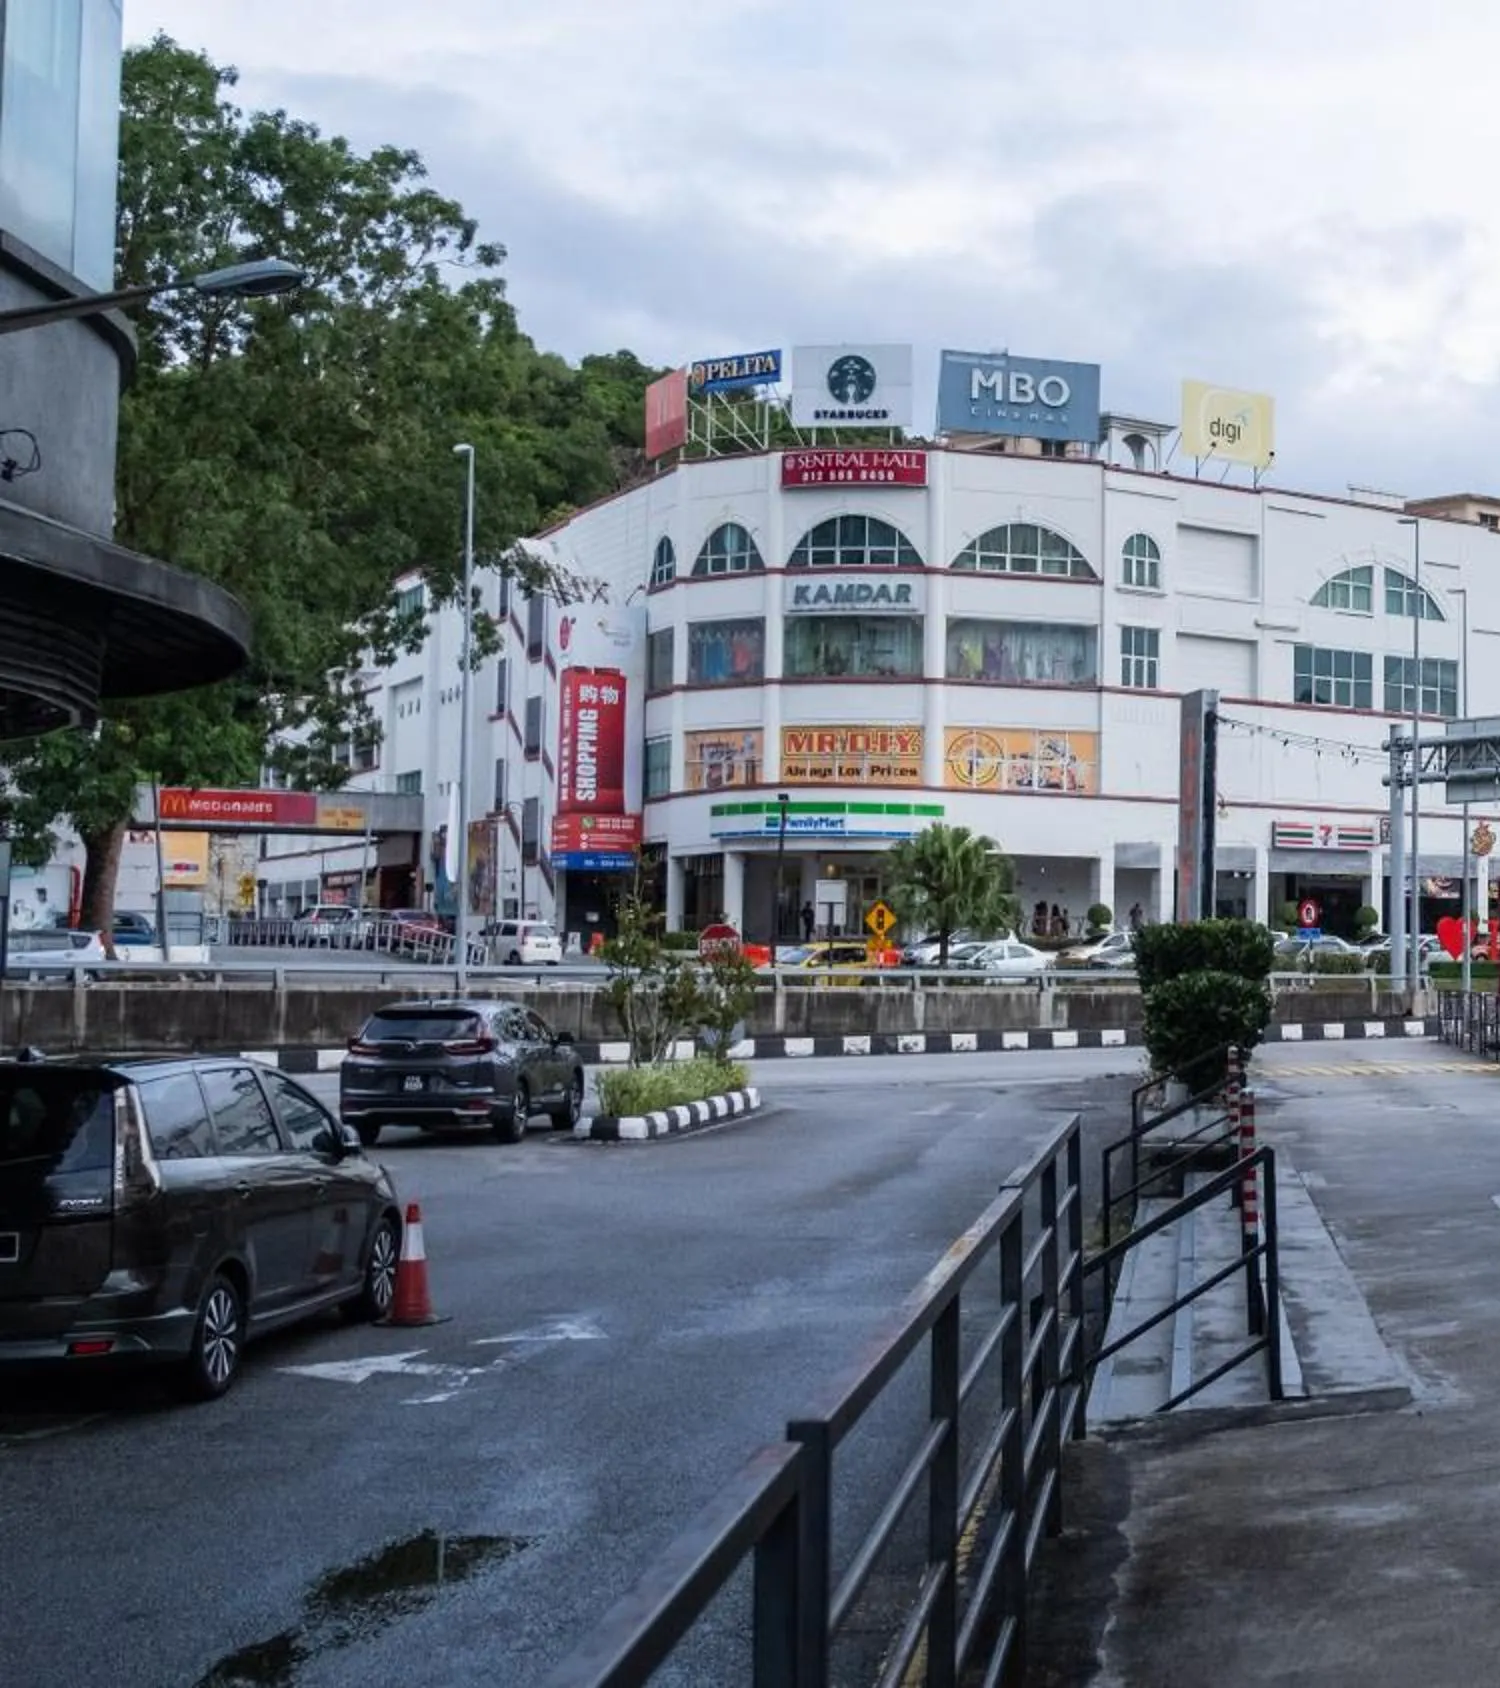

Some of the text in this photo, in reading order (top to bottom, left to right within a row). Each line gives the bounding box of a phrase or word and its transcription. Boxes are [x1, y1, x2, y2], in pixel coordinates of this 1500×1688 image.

[707, 355, 776, 381] PELITA
[970, 368, 1071, 407] MBO
[814, 409, 888, 420] STARBUCKS
[1209, 417, 1241, 445] digi
[798, 453, 921, 469] SENTRAL HALL
[794, 583, 912, 604] KAMDAR
[576, 709, 598, 801] SHOPPING
